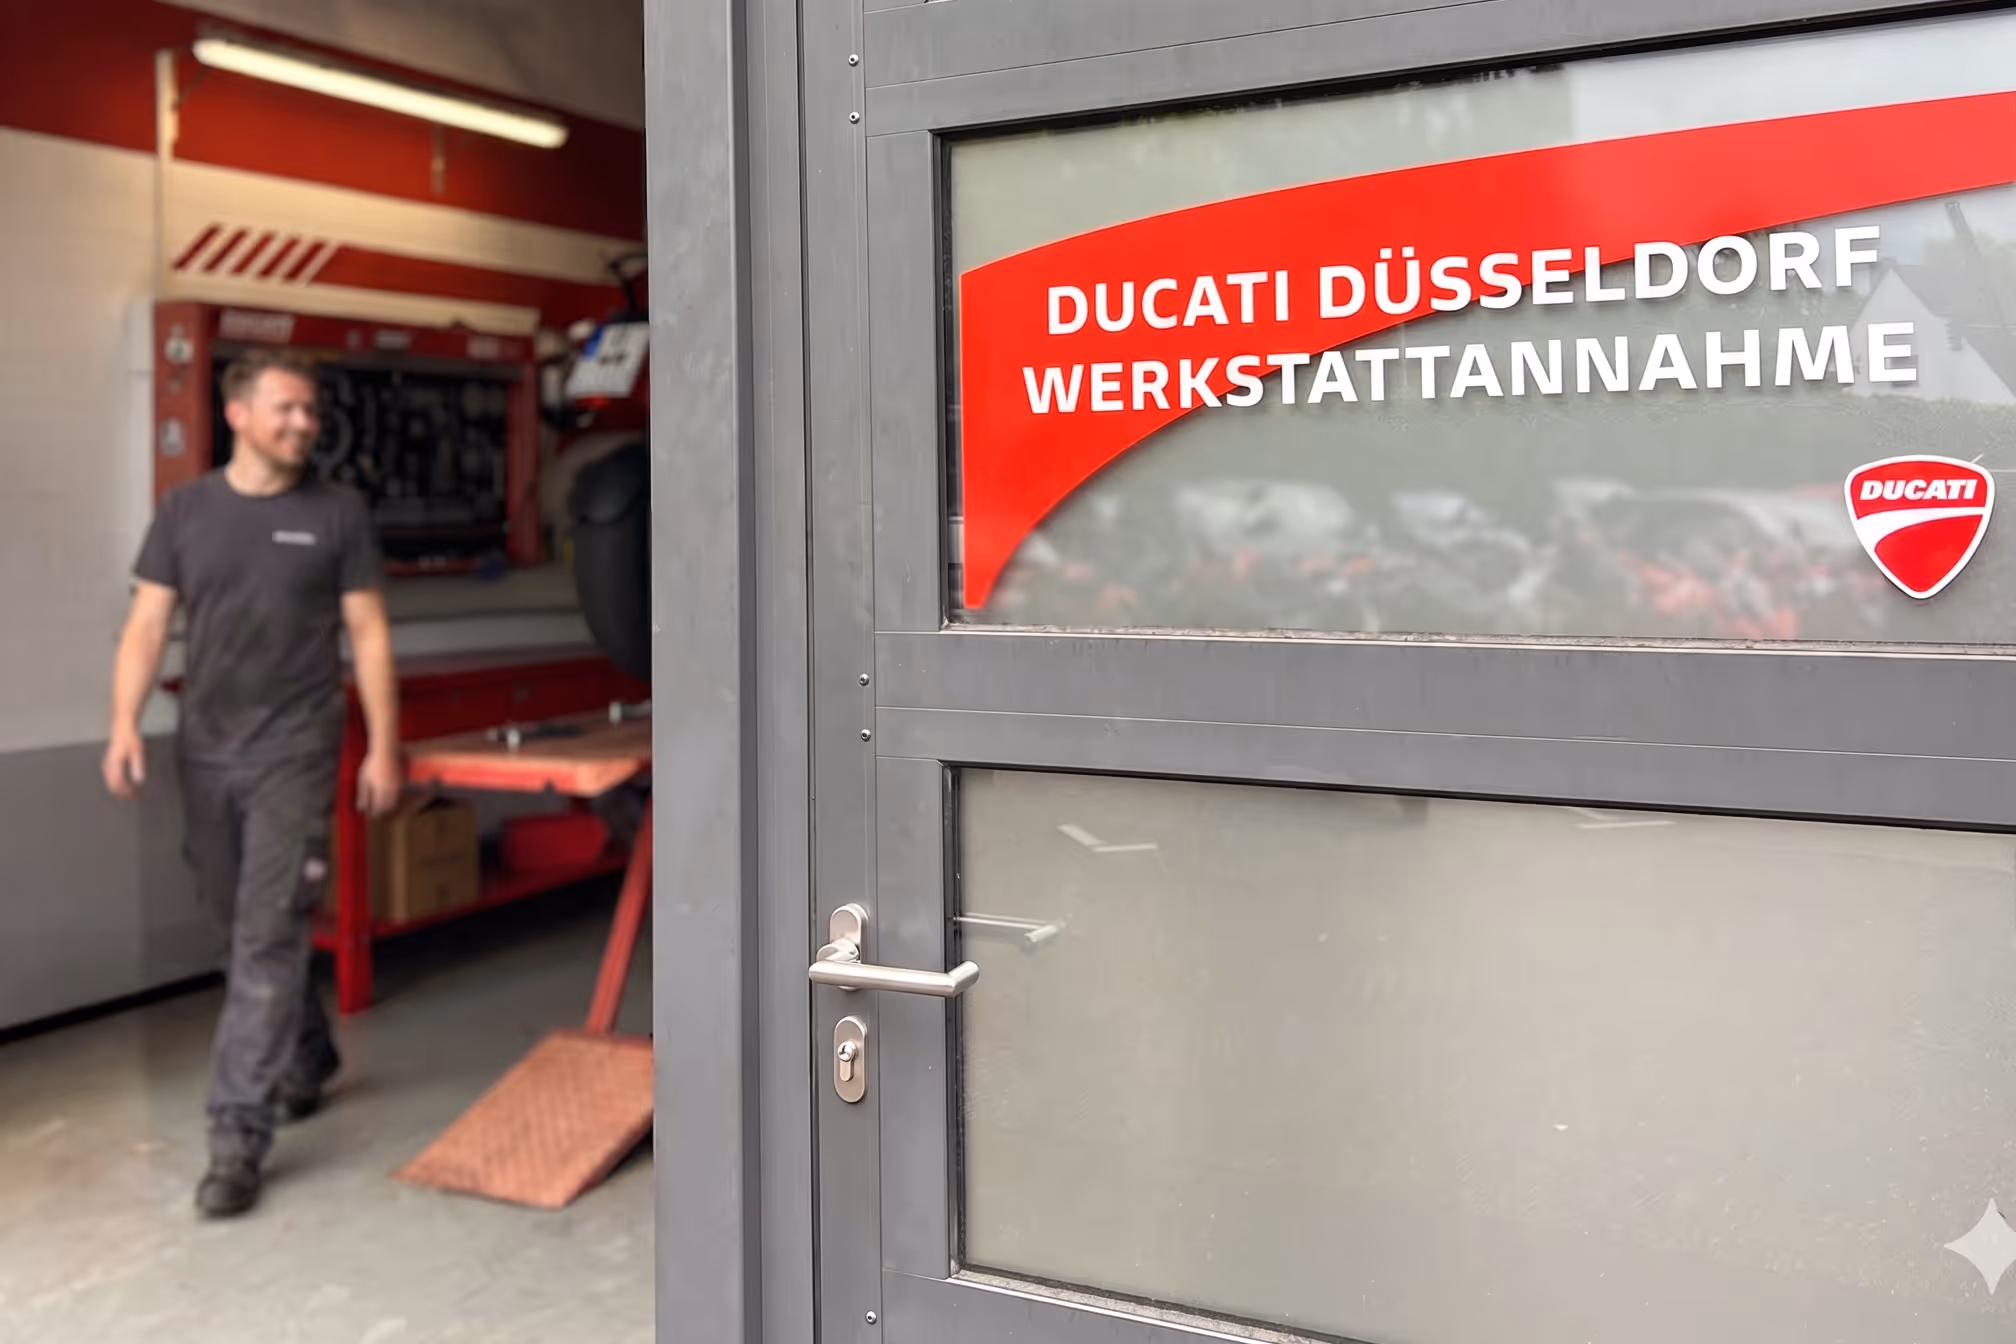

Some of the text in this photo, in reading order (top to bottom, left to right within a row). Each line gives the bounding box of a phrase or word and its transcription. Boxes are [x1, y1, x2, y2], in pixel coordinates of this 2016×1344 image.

[1047, 225, 1880, 335] DUCATI DÜSSELDORF
[1022, 322, 1917, 414] WERKSTATTANNAHME
[1860, 479, 1978, 501] DUCATI
